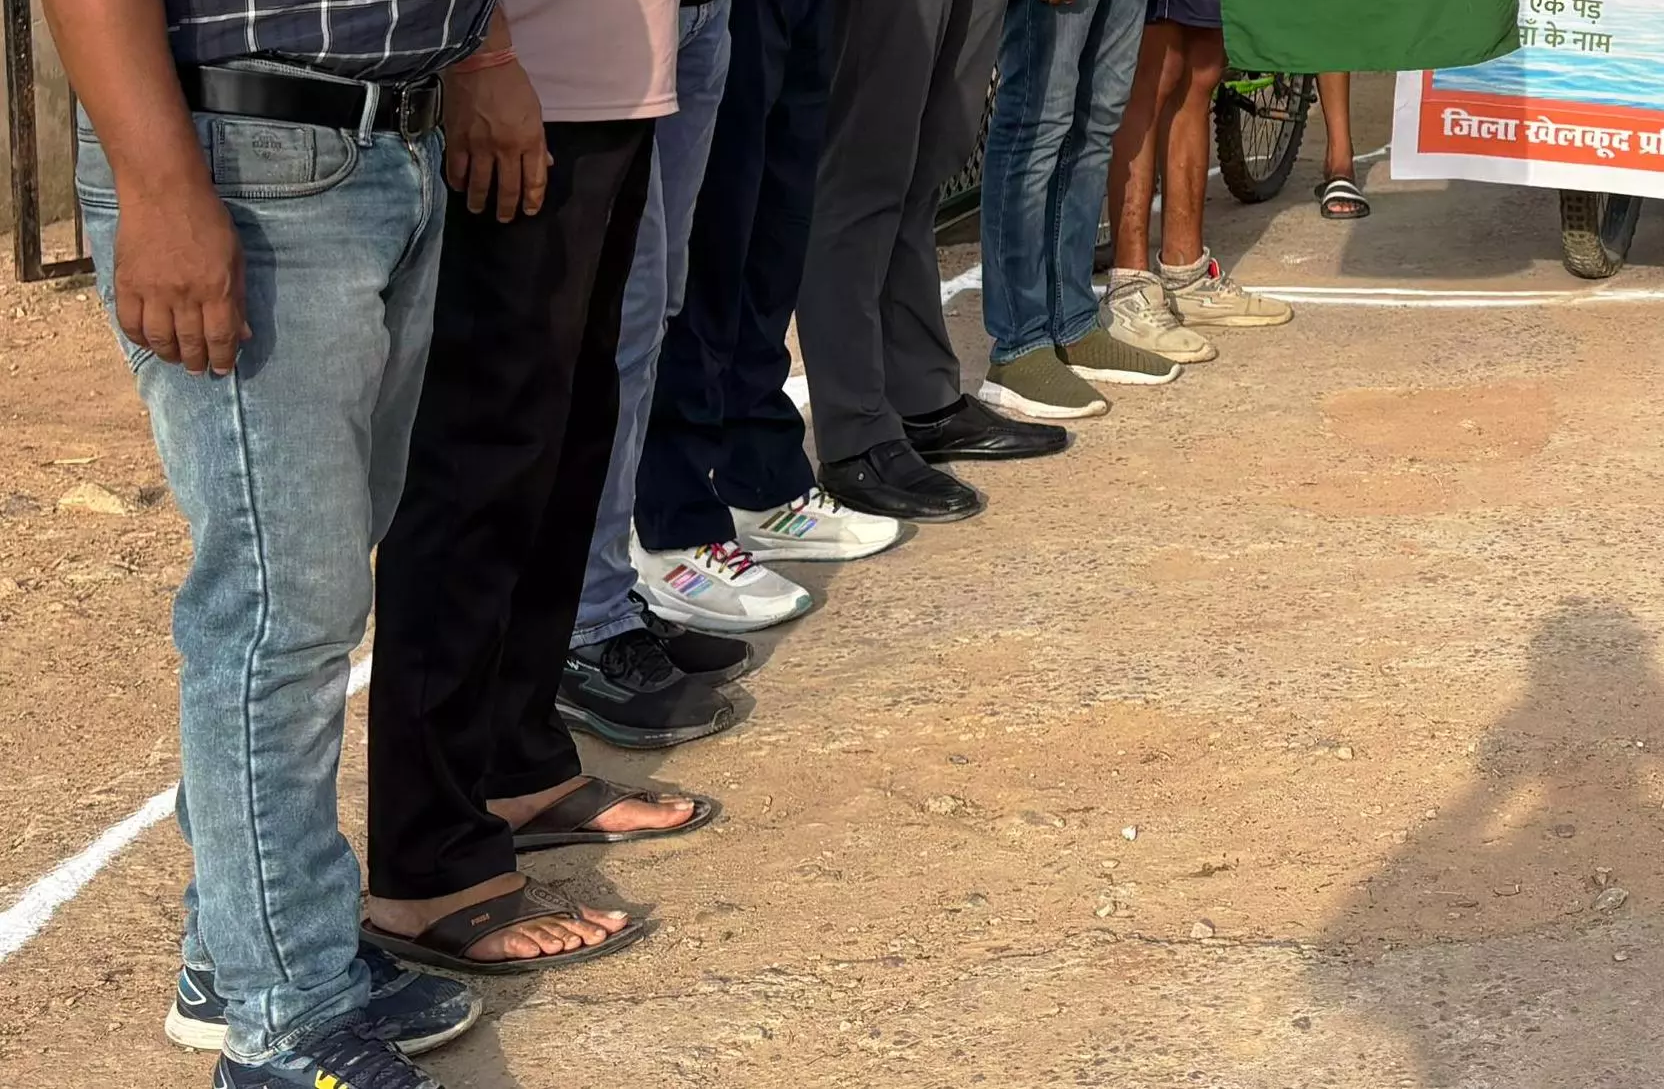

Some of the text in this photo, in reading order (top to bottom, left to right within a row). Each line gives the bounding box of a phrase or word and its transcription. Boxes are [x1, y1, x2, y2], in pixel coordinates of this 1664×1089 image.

[1544, 21, 1567, 48] के
[1572, 30, 1613, 53] नाम
[1441, 107, 1519, 143] जिला
[1524, 115, 1633, 159] खेलकूद
